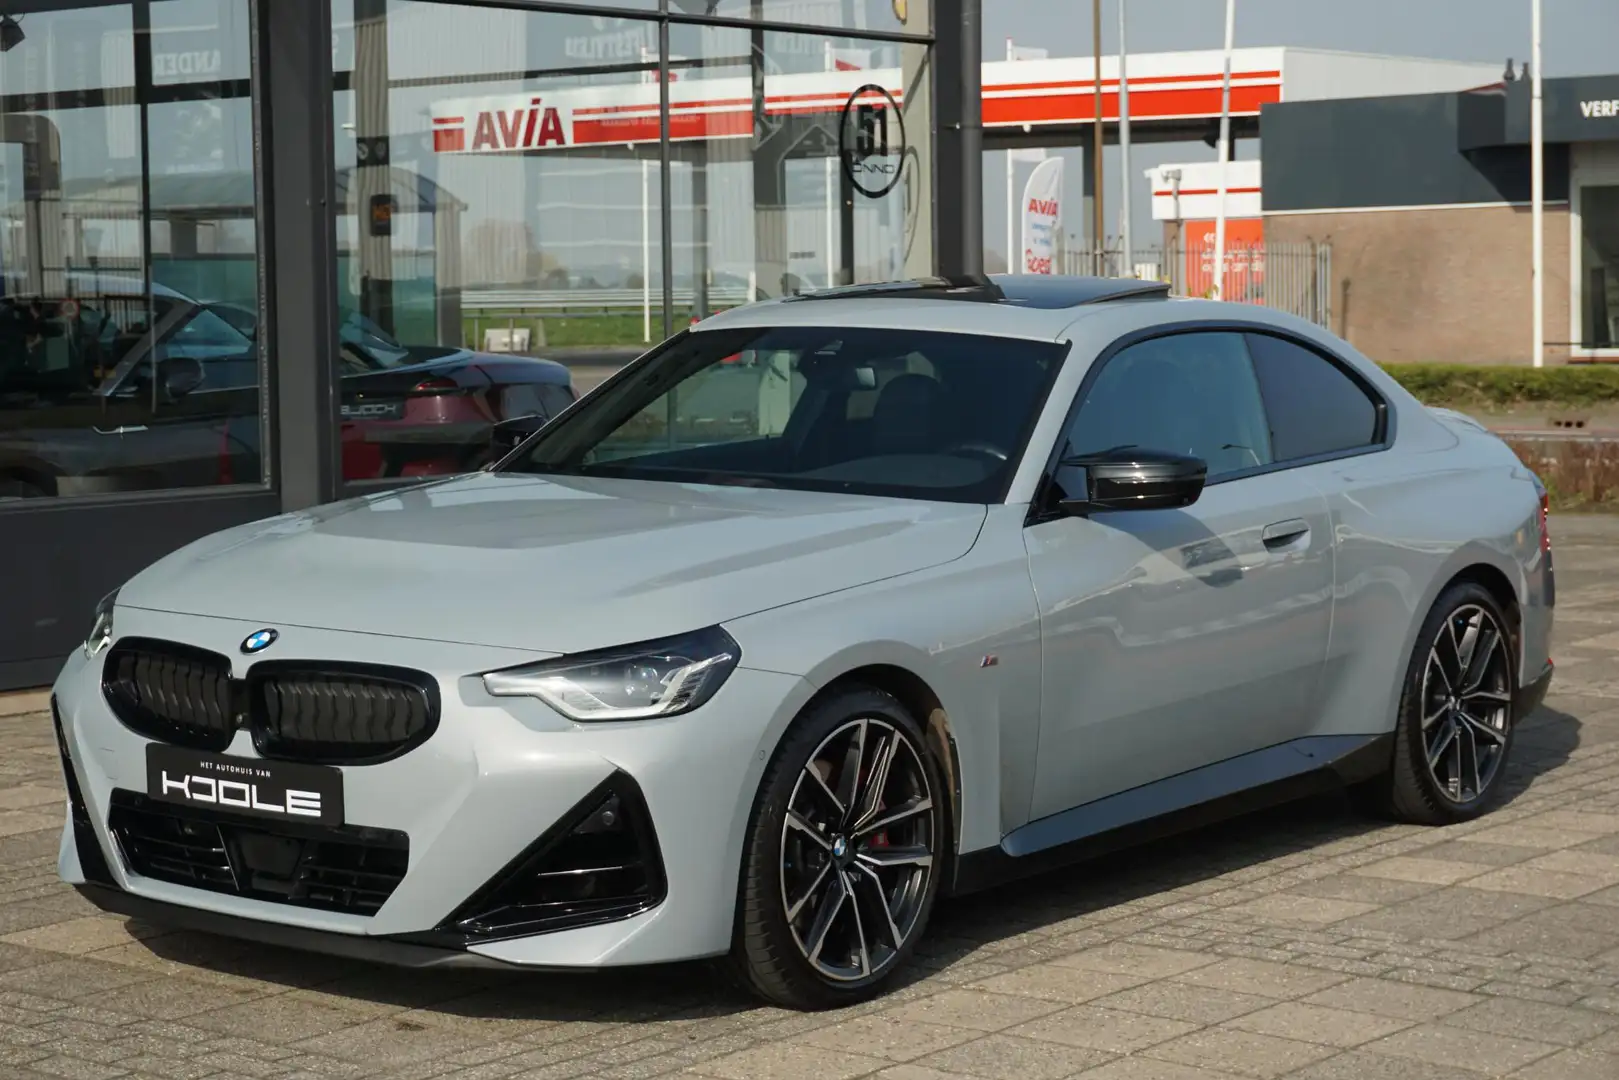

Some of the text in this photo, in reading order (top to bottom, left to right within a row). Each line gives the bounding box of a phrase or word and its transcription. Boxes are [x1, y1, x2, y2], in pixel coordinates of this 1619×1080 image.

[857, 103, 888, 157] 51
[200, 760, 271, 778] HET AUTOHUIS VAN
[161, 770, 322, 818] KOOLE
